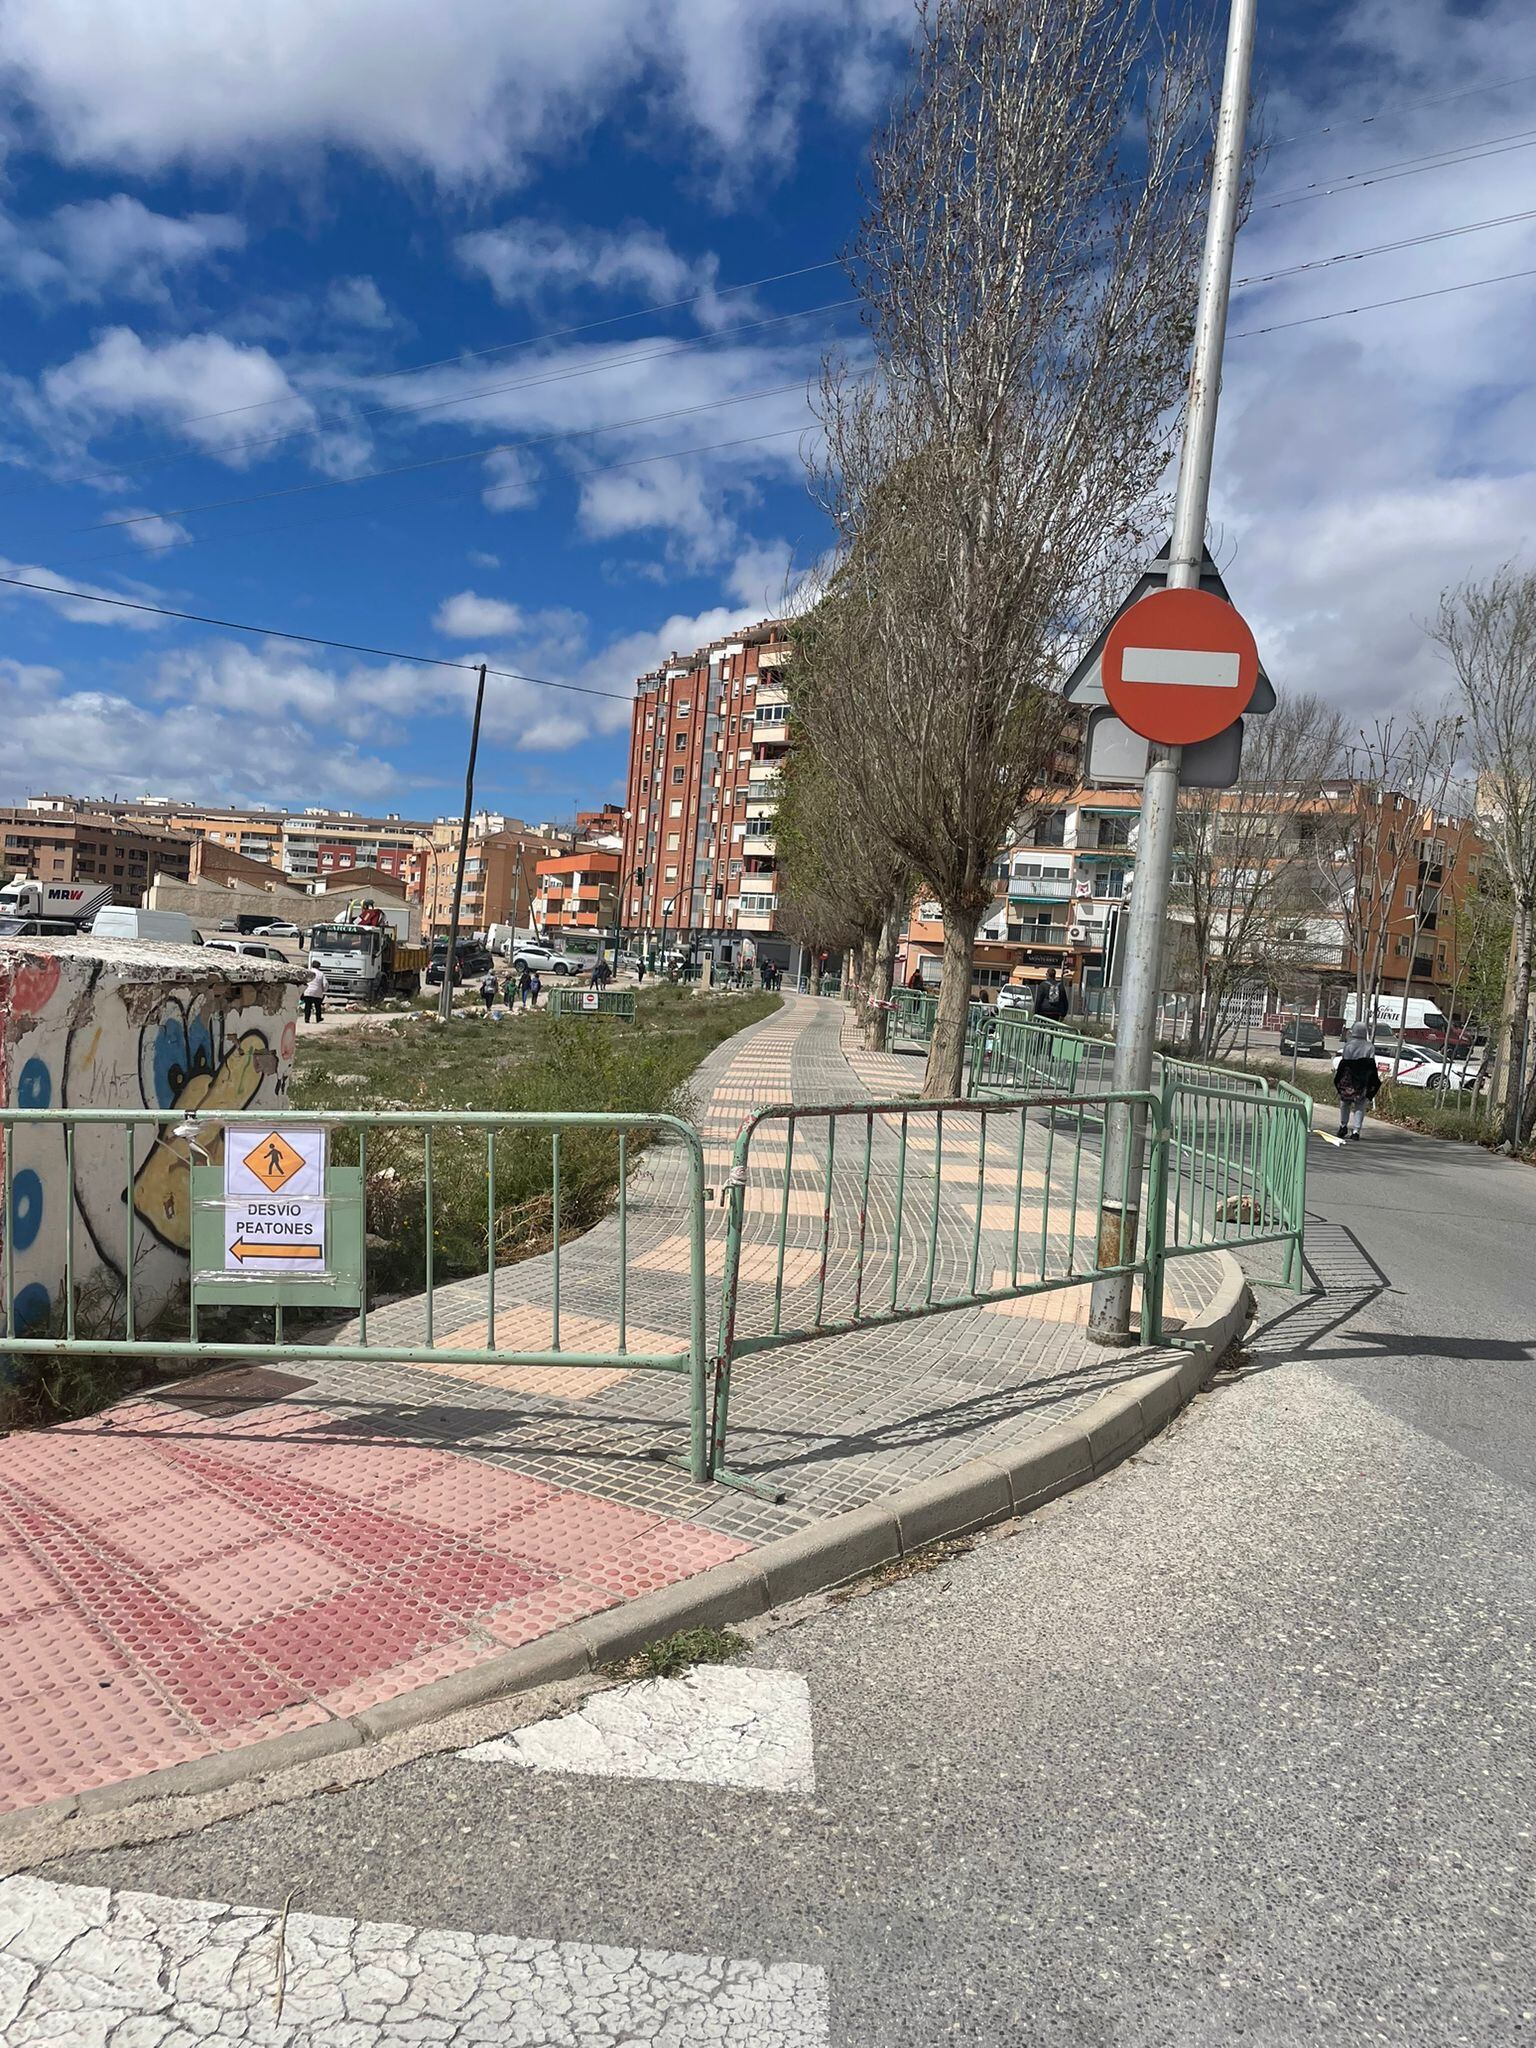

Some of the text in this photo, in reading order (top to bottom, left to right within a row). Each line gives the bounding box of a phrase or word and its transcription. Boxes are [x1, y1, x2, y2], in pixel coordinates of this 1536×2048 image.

[48, 889, 84, 900] MRW
[248, 1201, 302, 1217] DESVÍO
[236, 1221, 314, 1235] PEATONES
